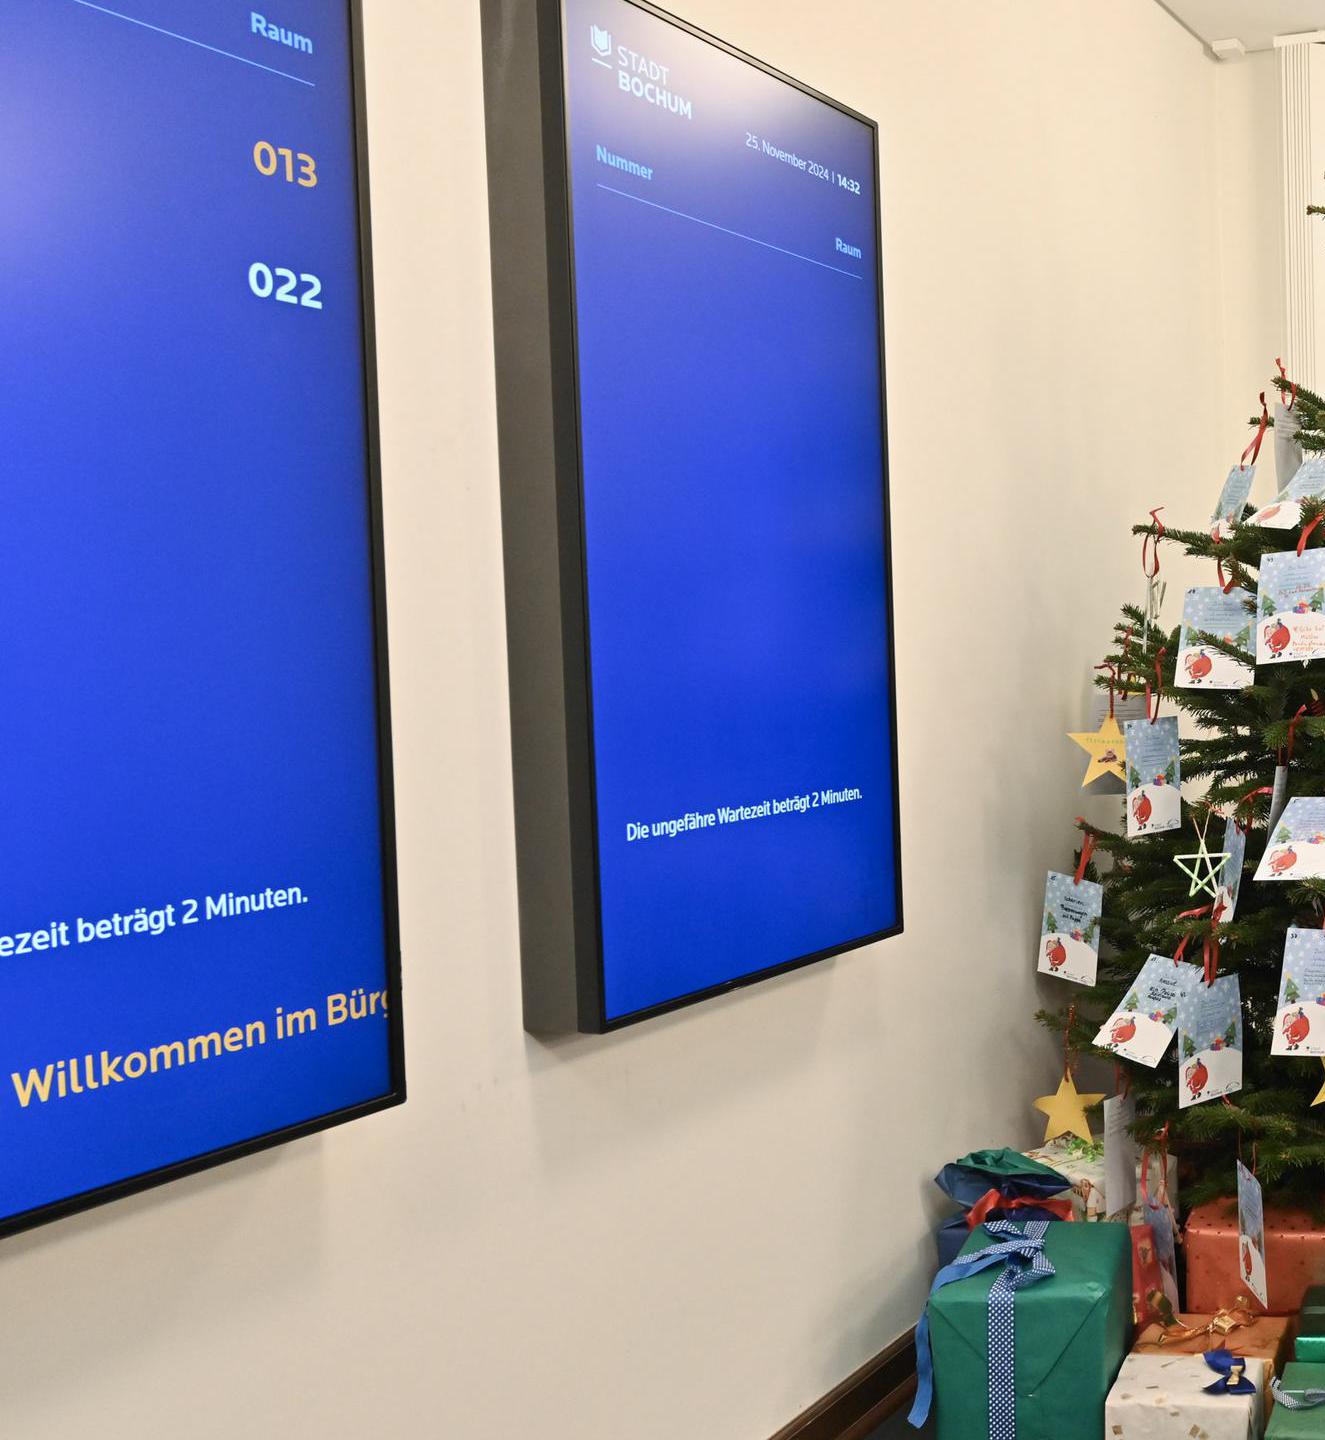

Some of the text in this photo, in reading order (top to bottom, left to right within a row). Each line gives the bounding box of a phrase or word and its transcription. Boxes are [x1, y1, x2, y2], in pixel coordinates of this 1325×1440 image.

[250, 11, 314, 55] Raum
[617, 45, 670, 85] STADT
[617, 70, 692, 120] BOCHUM
[252, 140, 319, 189] 013
[596, 144, 654, 181] Nummer
[745, 132, 761, 152] 25.
[762, 139, 807, 171] November
[808, 160, 829, 181] 2024
[837, 173, 861, 195] 14:32
[835, 236, 862, 260] Raum
[247, 262, 323, 311] 022
[626, 787, 863, 842] Die ungefähre Wartezeit beträgt 2 Minuten.
[77, 903, 176, 943] beträgt
[181, 898, 200, 925] 2
[205, 886, 309, 920] Minuten.
[11, 1020, 267, 1108] Willkommen
[275, 1006, 318, 1040] im
